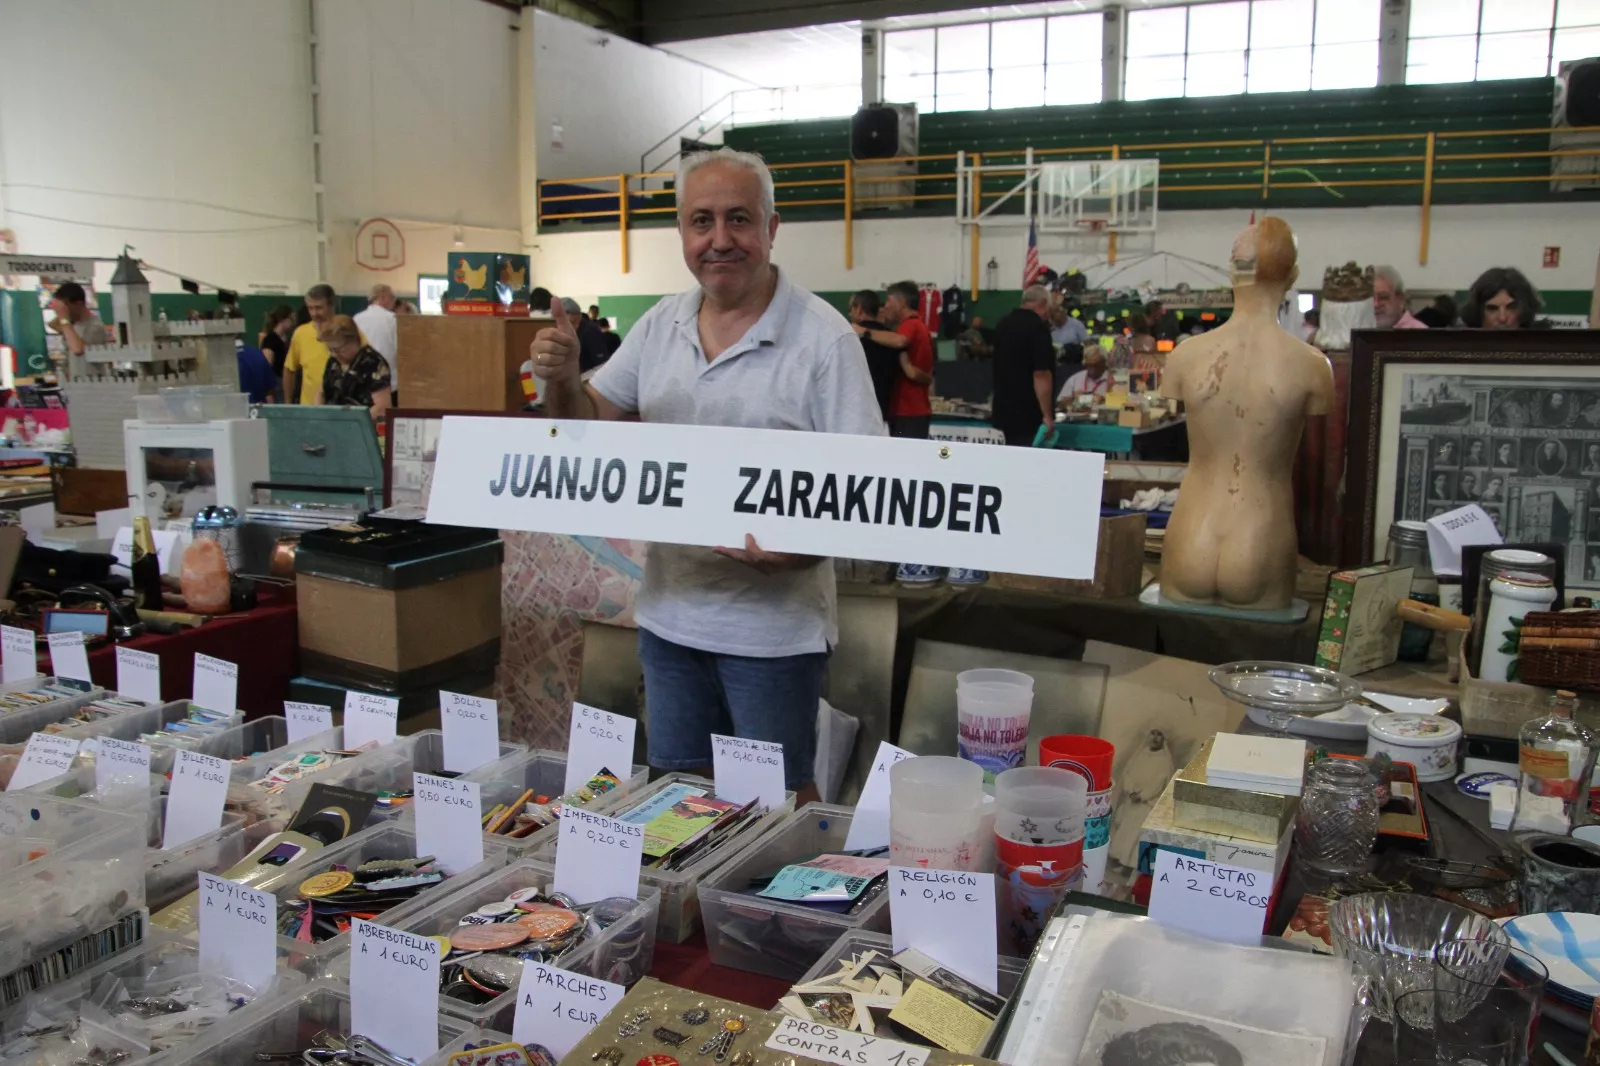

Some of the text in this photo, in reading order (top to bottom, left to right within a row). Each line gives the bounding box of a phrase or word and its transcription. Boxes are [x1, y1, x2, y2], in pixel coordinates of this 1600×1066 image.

[7, 261, 76, 273] TODOCARTEL
[489, 453, 1003, 535] JUANJO DE ZARAKINDER
[359, 695, 387, 707] SELLOS
[452, 694, 482, 708] BOLIS
[457, 708, 477, 720] 0,20
[479, 713, 489, 721] €
[576, 722, 624, 743] A 0,20 €
[715, 736, 748, 748] PUNTOS
[101, 739, 141, 752] MEDALLAS
[181, 750, 221, 769] BILLETES
[757, 755, 778, 766] EURO
[878, 762, 885, 772] A
[179, 765, 185, 774] A
[203, 771, 224, 784] EURO
[417, 775, 469, 793] IMANES A
[419, 789, 473, 809] 0,50 EURO
[570, 826, 630, 849] A 0,20 €
[901, 887, 981, 903] A 0,10 €
[1160, 872, 1268, 909] A 2 EUROS
[206, 897, 267, 925] A 1 EURO
[358, 923, 437, 954] ABREBOTELLAS
[361, 942, 428, 971] A 1 EURO
[536, 967, 607, 1002] PARCHES
[525, 993, 599, 1025] A 1 EUR
[785, 1019, 877, 1048] PROS Y
[775, 1034, 868, 1064] CONTRAS
